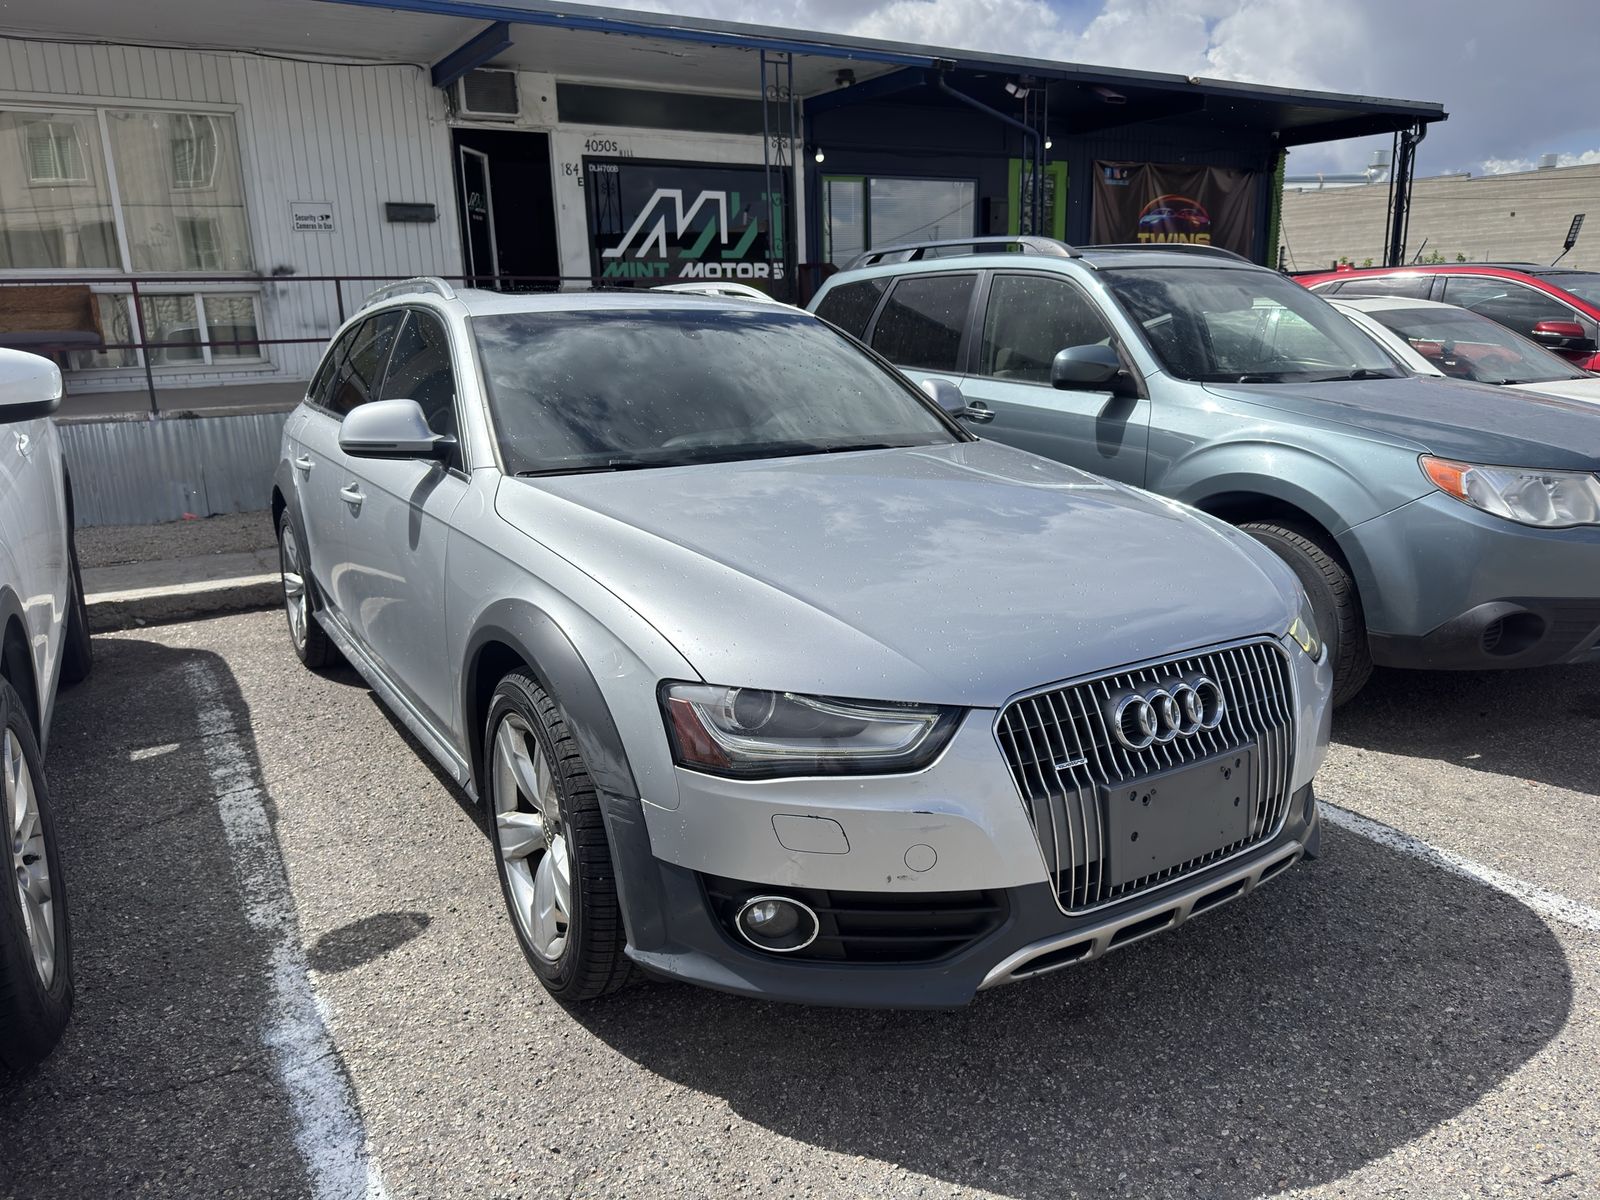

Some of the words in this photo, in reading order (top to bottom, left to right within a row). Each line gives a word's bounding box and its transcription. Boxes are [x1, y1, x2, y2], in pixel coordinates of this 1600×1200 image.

[294, 213, 316, 223] Security
[295, 222, 317, 230] Cameras
[602, 262, 670, 278] MINT
[678, 262, 784, 279] MOTORS
